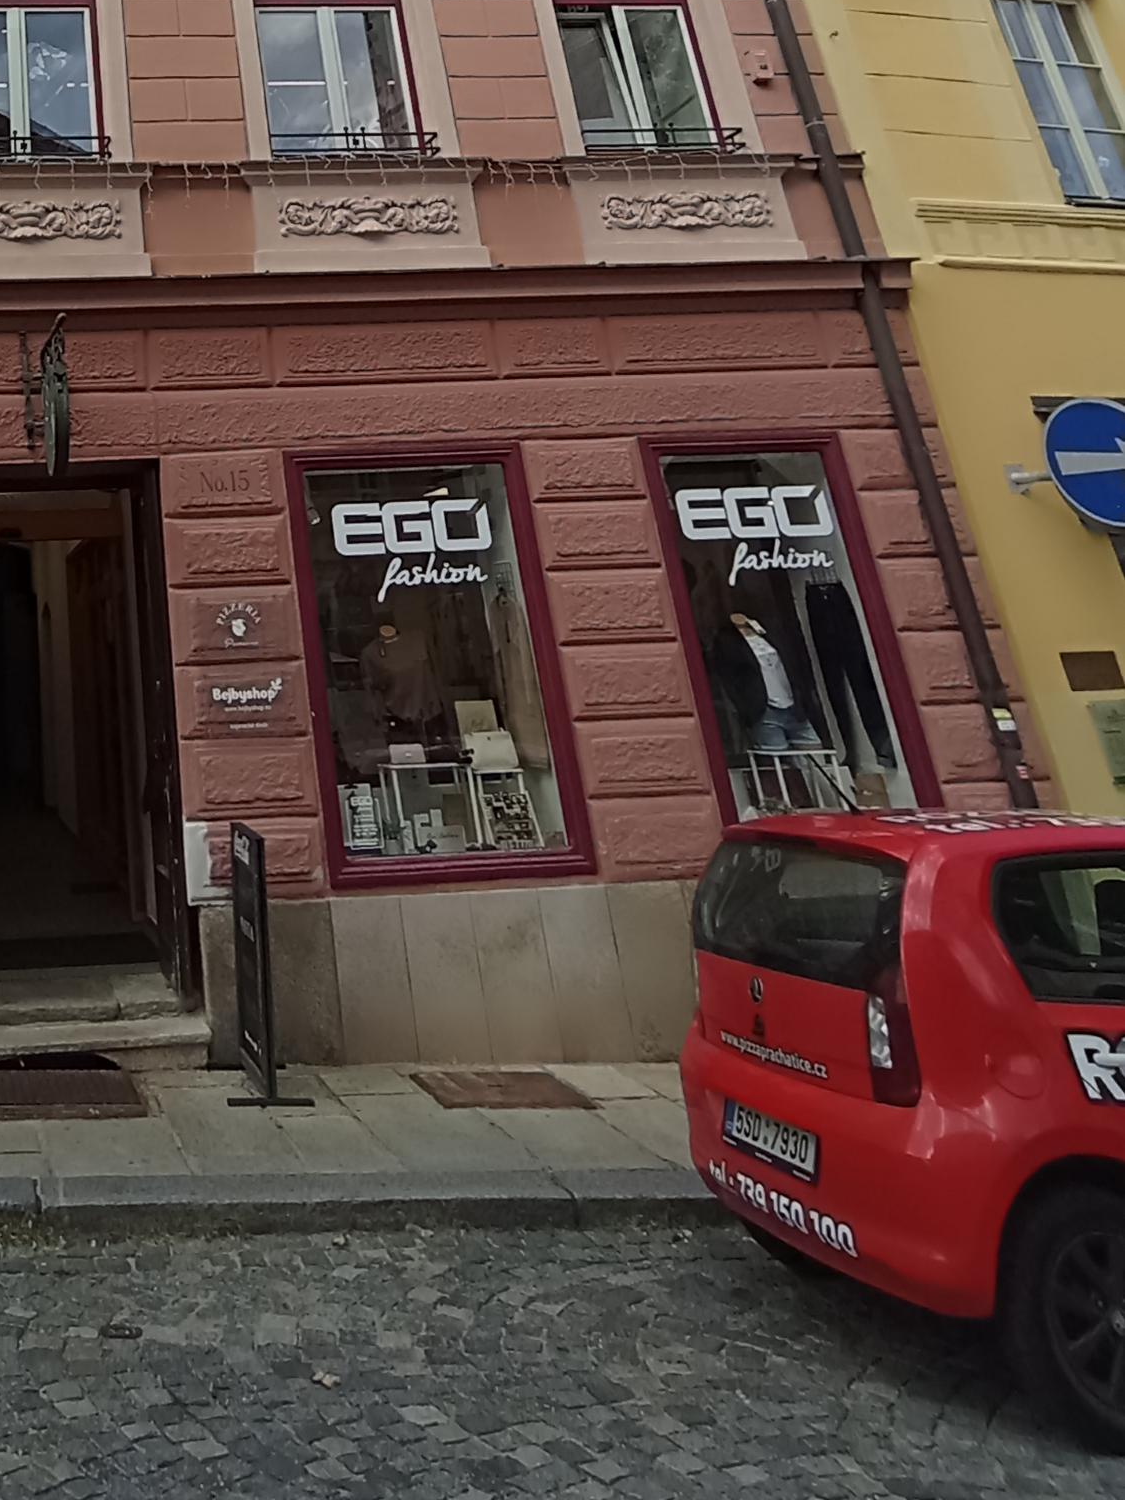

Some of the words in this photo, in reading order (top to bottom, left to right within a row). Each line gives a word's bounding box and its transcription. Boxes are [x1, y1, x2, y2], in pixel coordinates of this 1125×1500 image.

[331, 498, 493, 556] EGO
[675, 485, 834, 540] EGO
[377, 552, 489, 603] fashion
[728, 538, 834, 587] fashion
[216, 602, 263, 626] PIZZERIA
[212, 686, 276, 704] Bejbyshop
[720, 1029, 828, 1079] www.pizzaprachatice.cz
[770, 1191, 809, 1234] 150
[809, 1209, 858, 1258] 100
